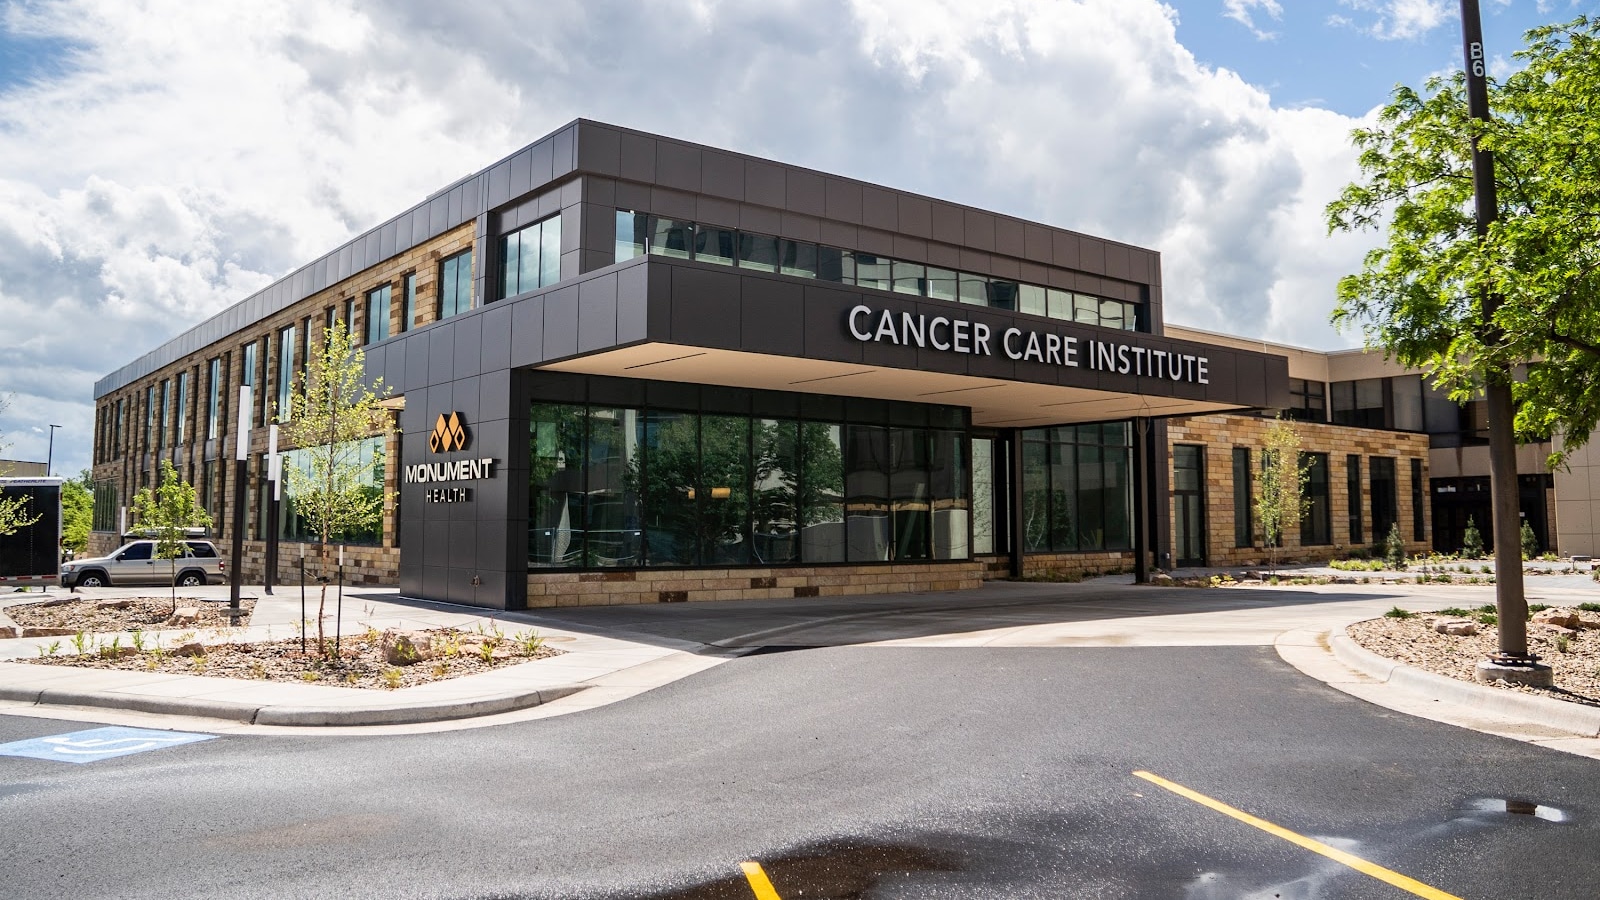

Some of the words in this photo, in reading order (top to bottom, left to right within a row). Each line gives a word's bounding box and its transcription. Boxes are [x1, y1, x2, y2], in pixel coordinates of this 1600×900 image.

[849, 305, 991, 356] CANCER
[1003, 327, 1079, 367] CARE
[1089, 340, 1209, 385] INSTITUTE
[405, 458, 493, 483] MONUMENT
[426, 488, 466, 503] HEALTH
